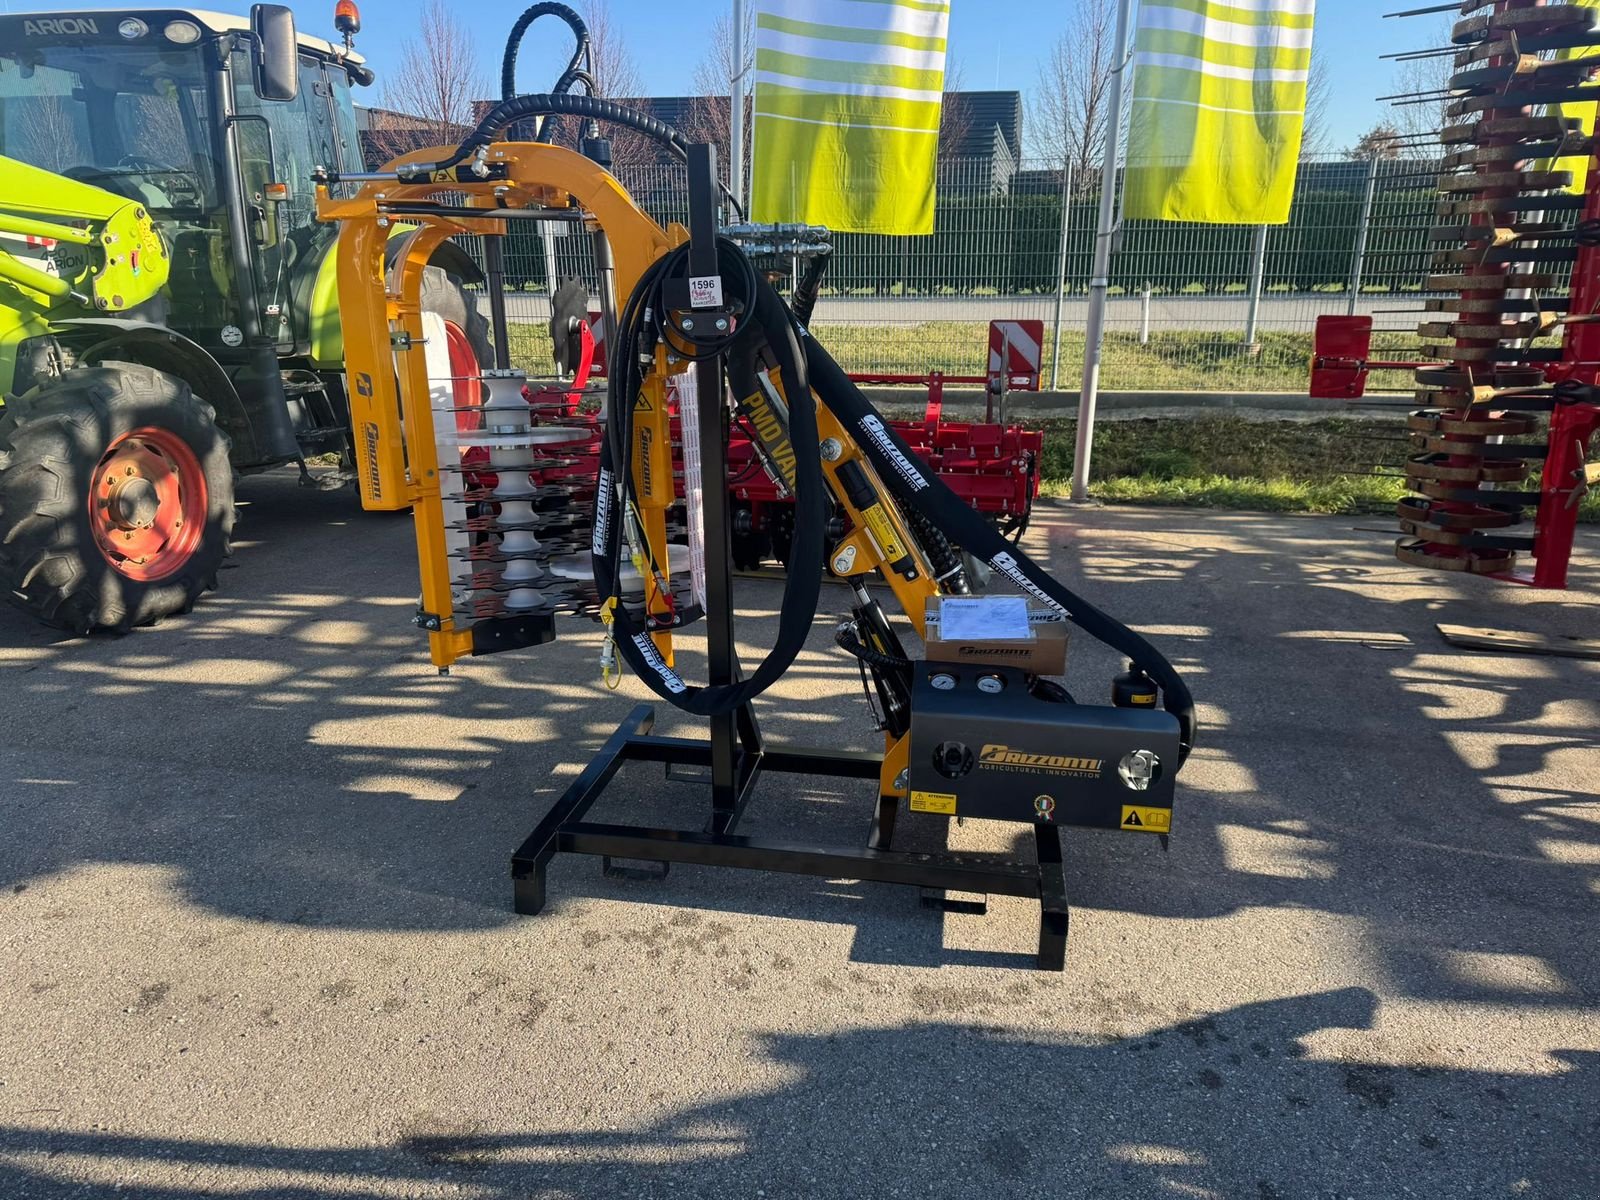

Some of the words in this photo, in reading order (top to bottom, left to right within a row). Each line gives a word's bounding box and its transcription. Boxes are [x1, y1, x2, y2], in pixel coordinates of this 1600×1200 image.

[23, 18, 99, 36] ARION
[46, 256, 84, 273] ARION
[692, 280, 715, 290] 1596
[742, 391, 782, 442] PMD
[771, 439, 797, 492] VAR
[857, 421, 889, 460] AGRICULTURAL
[889, 461, 919, 492] INNOVATION
[979, 764, 1041, 775] AGRICULTURAL
[1045, 769, 1101, 779] INNOVATION
